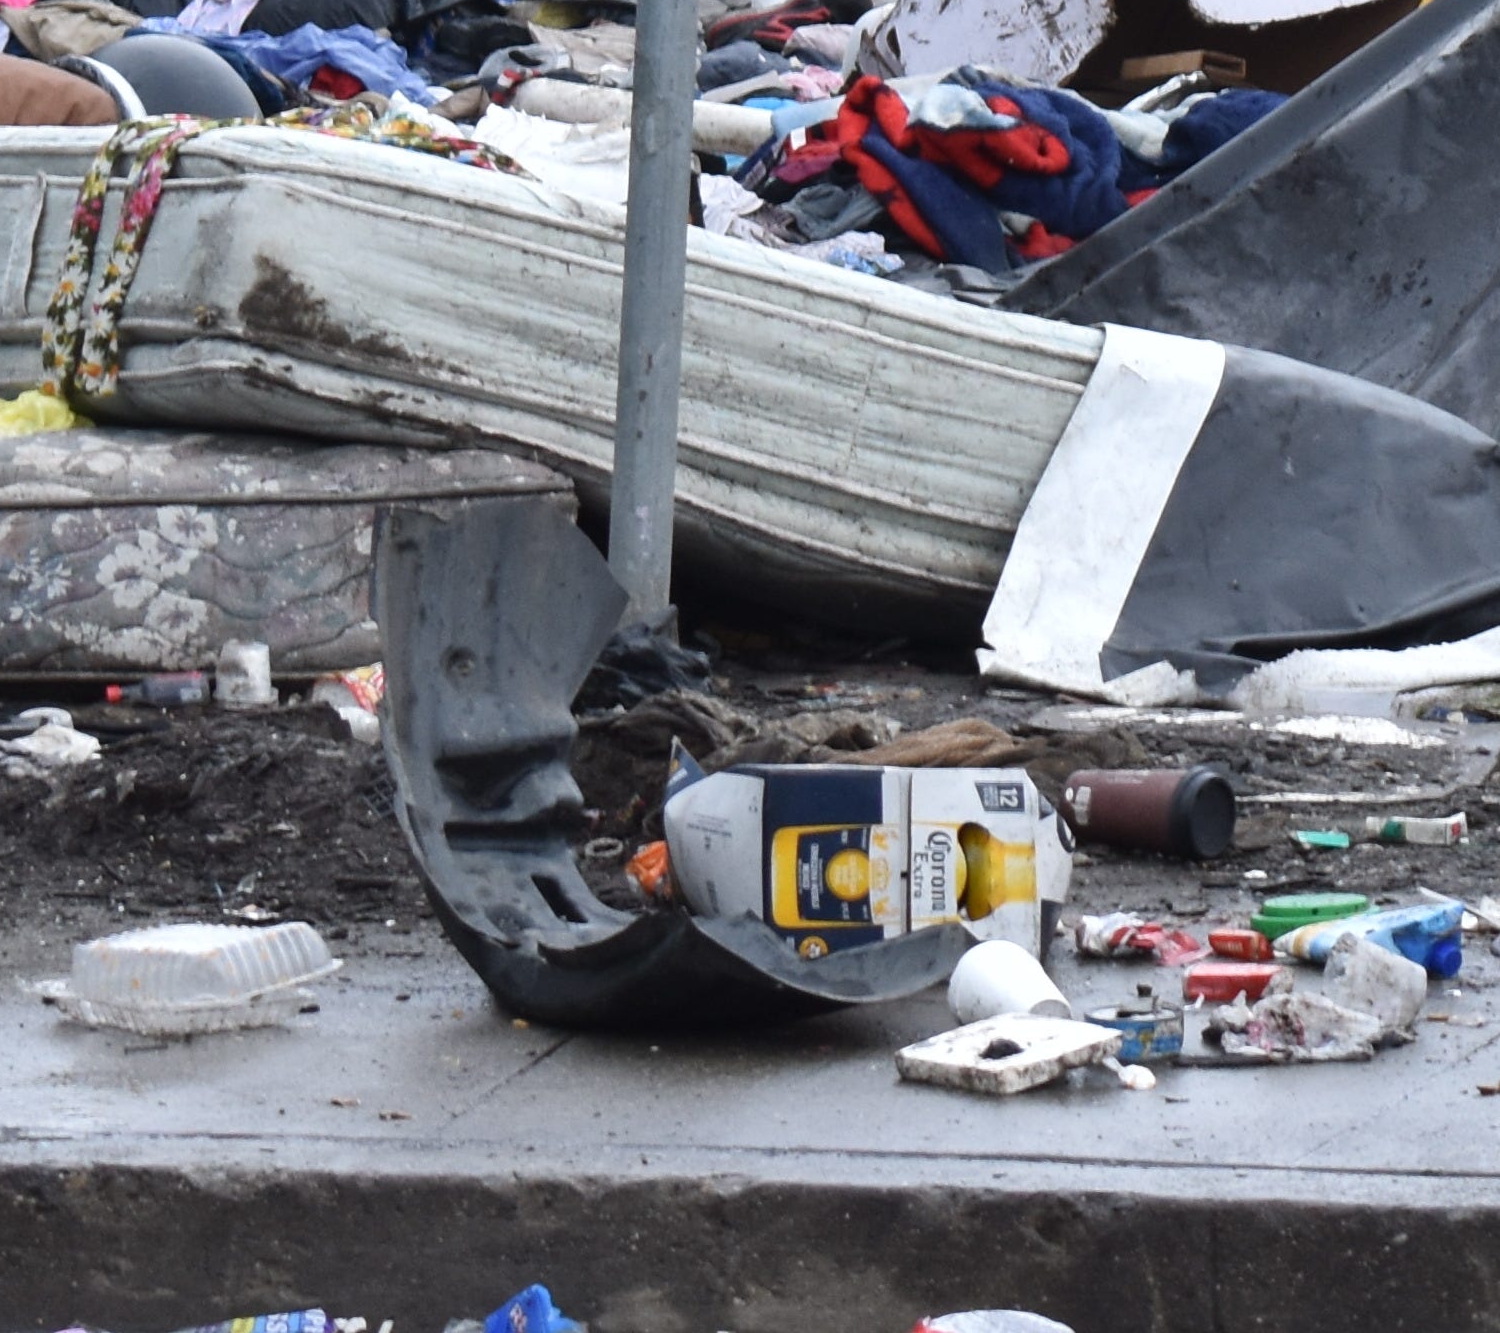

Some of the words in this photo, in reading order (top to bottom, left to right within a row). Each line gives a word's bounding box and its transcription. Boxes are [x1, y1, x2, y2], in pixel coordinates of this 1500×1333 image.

[1000, 785, 1020, 810] 12
[913, 851, 929, 899] Extra
[927, 830, 954, 912] Corona
